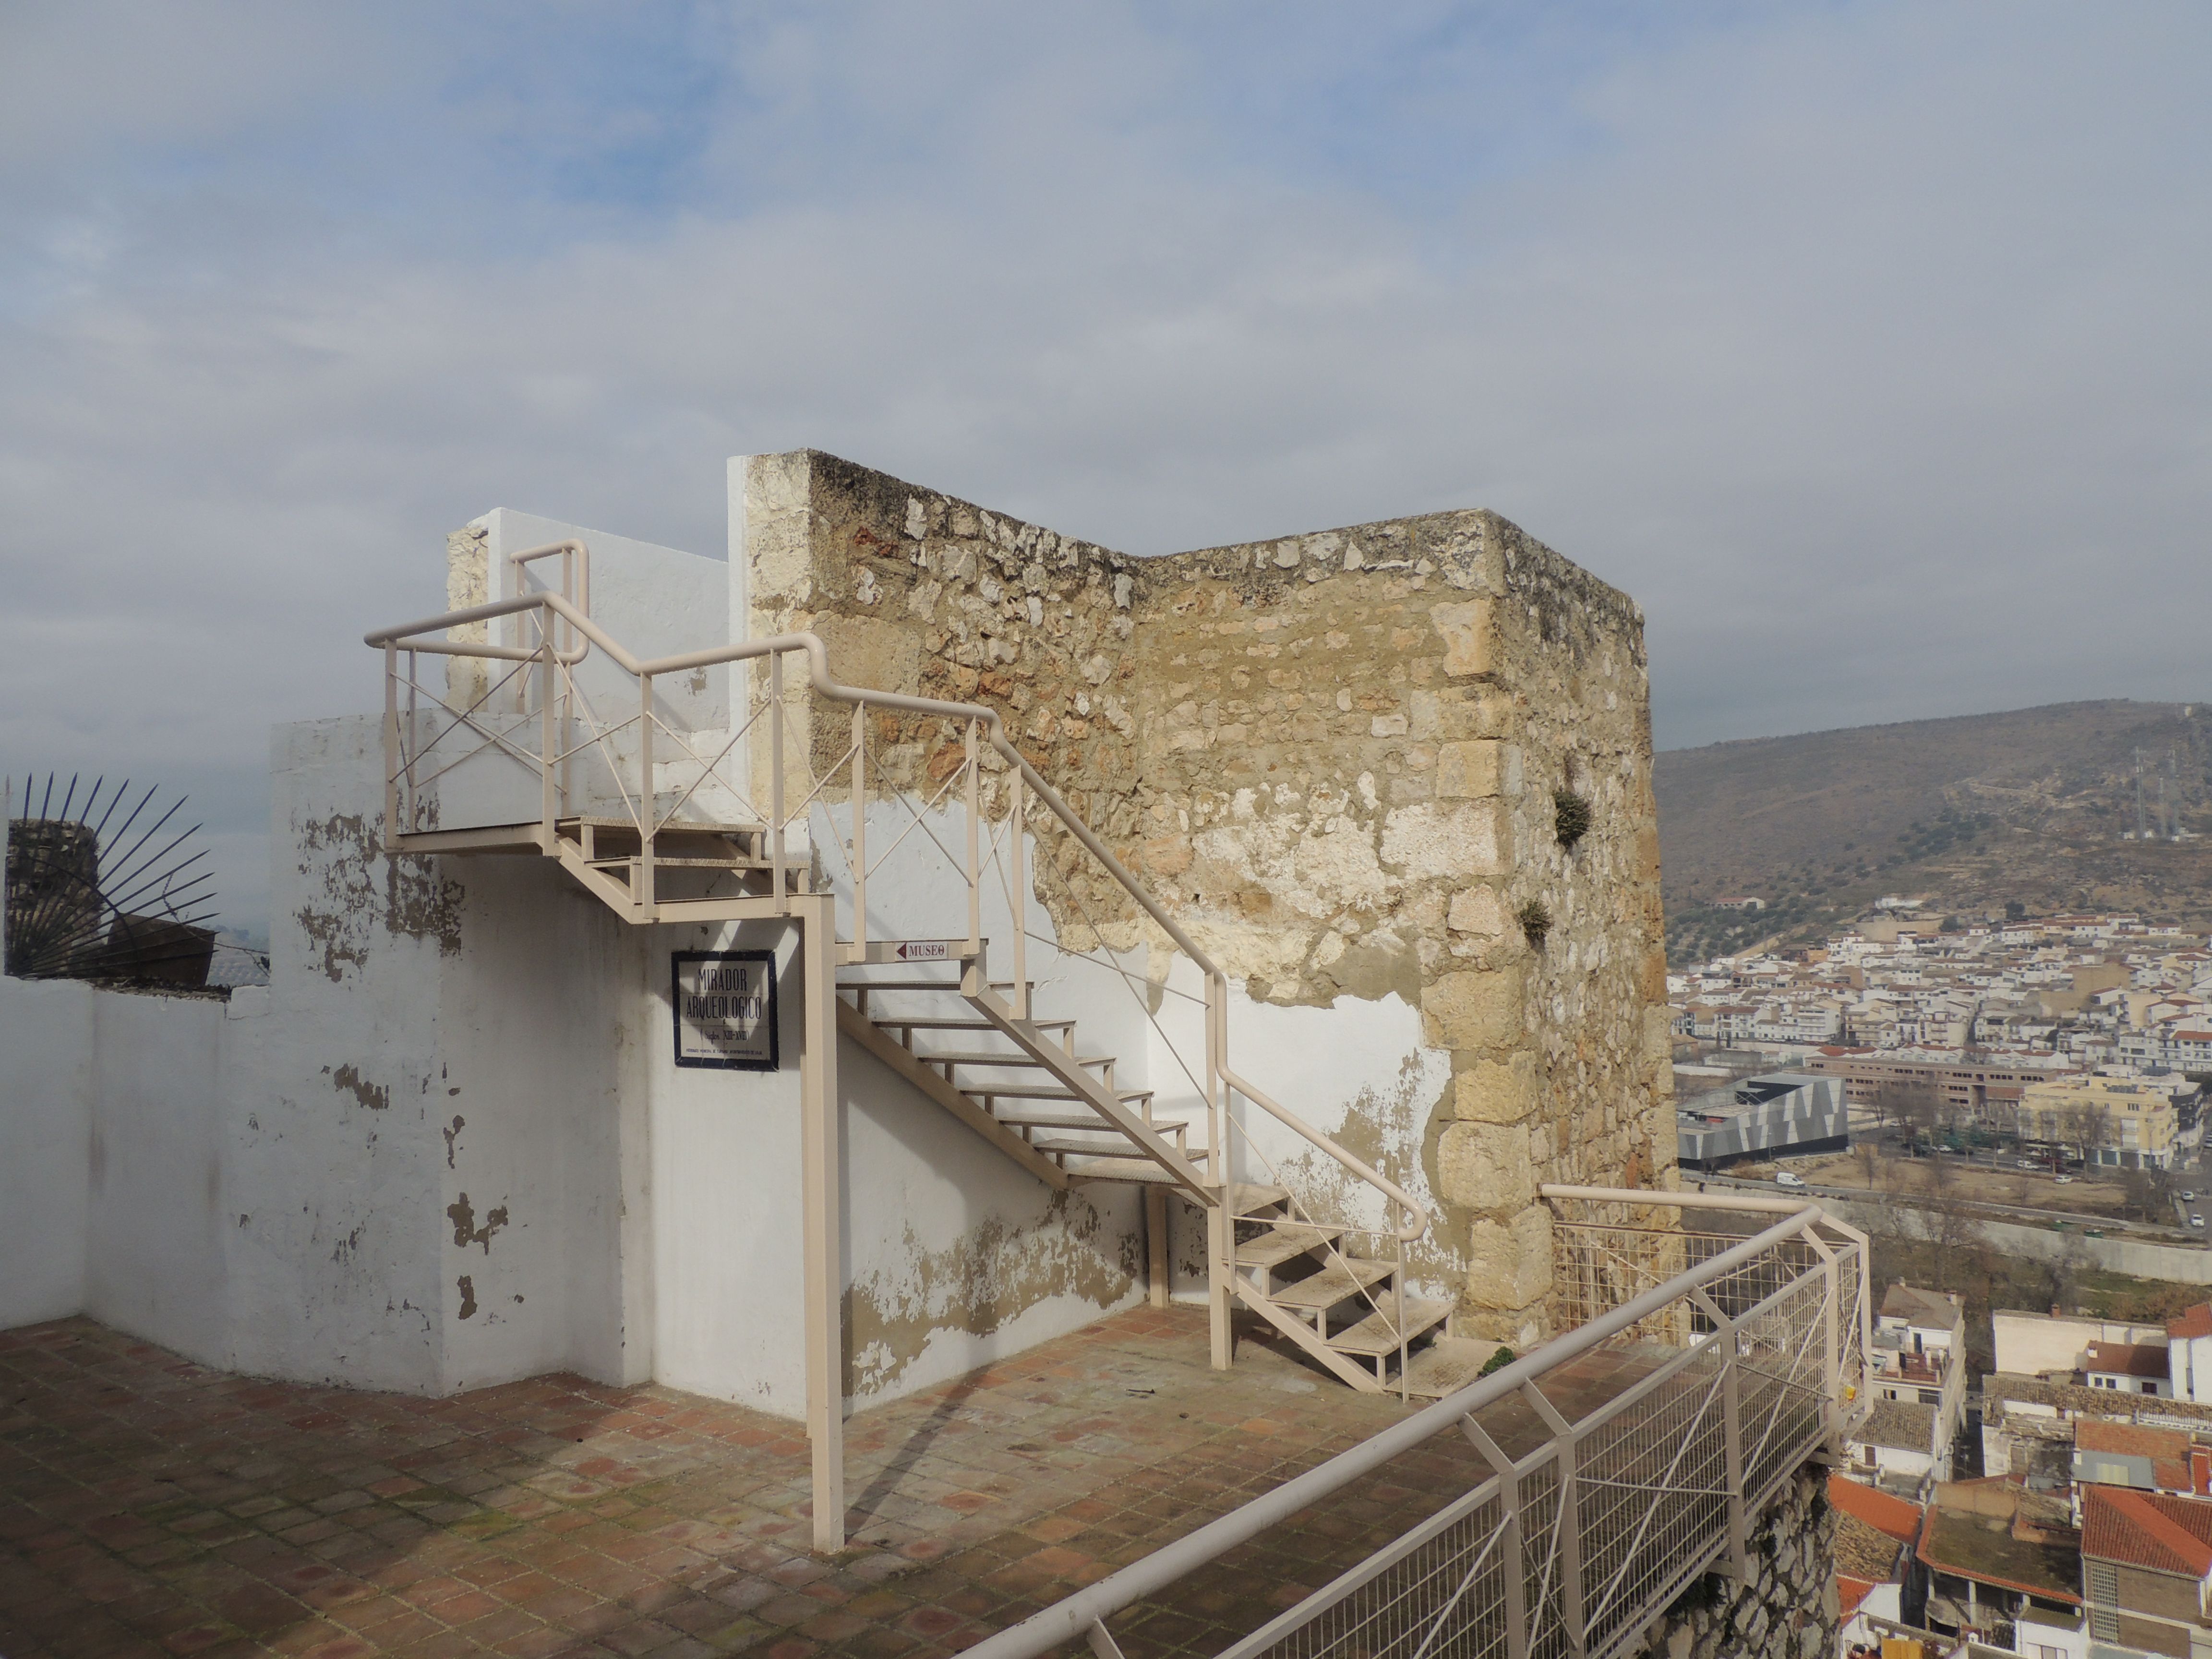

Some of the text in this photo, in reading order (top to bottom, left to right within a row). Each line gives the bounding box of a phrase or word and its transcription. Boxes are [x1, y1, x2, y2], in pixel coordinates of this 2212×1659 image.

[909, 944, 944, 956] MUSEO
[698, 968, 747, 991] MIRADOR
[686, 996, 761, 1020] ARQUEOLOGICO
